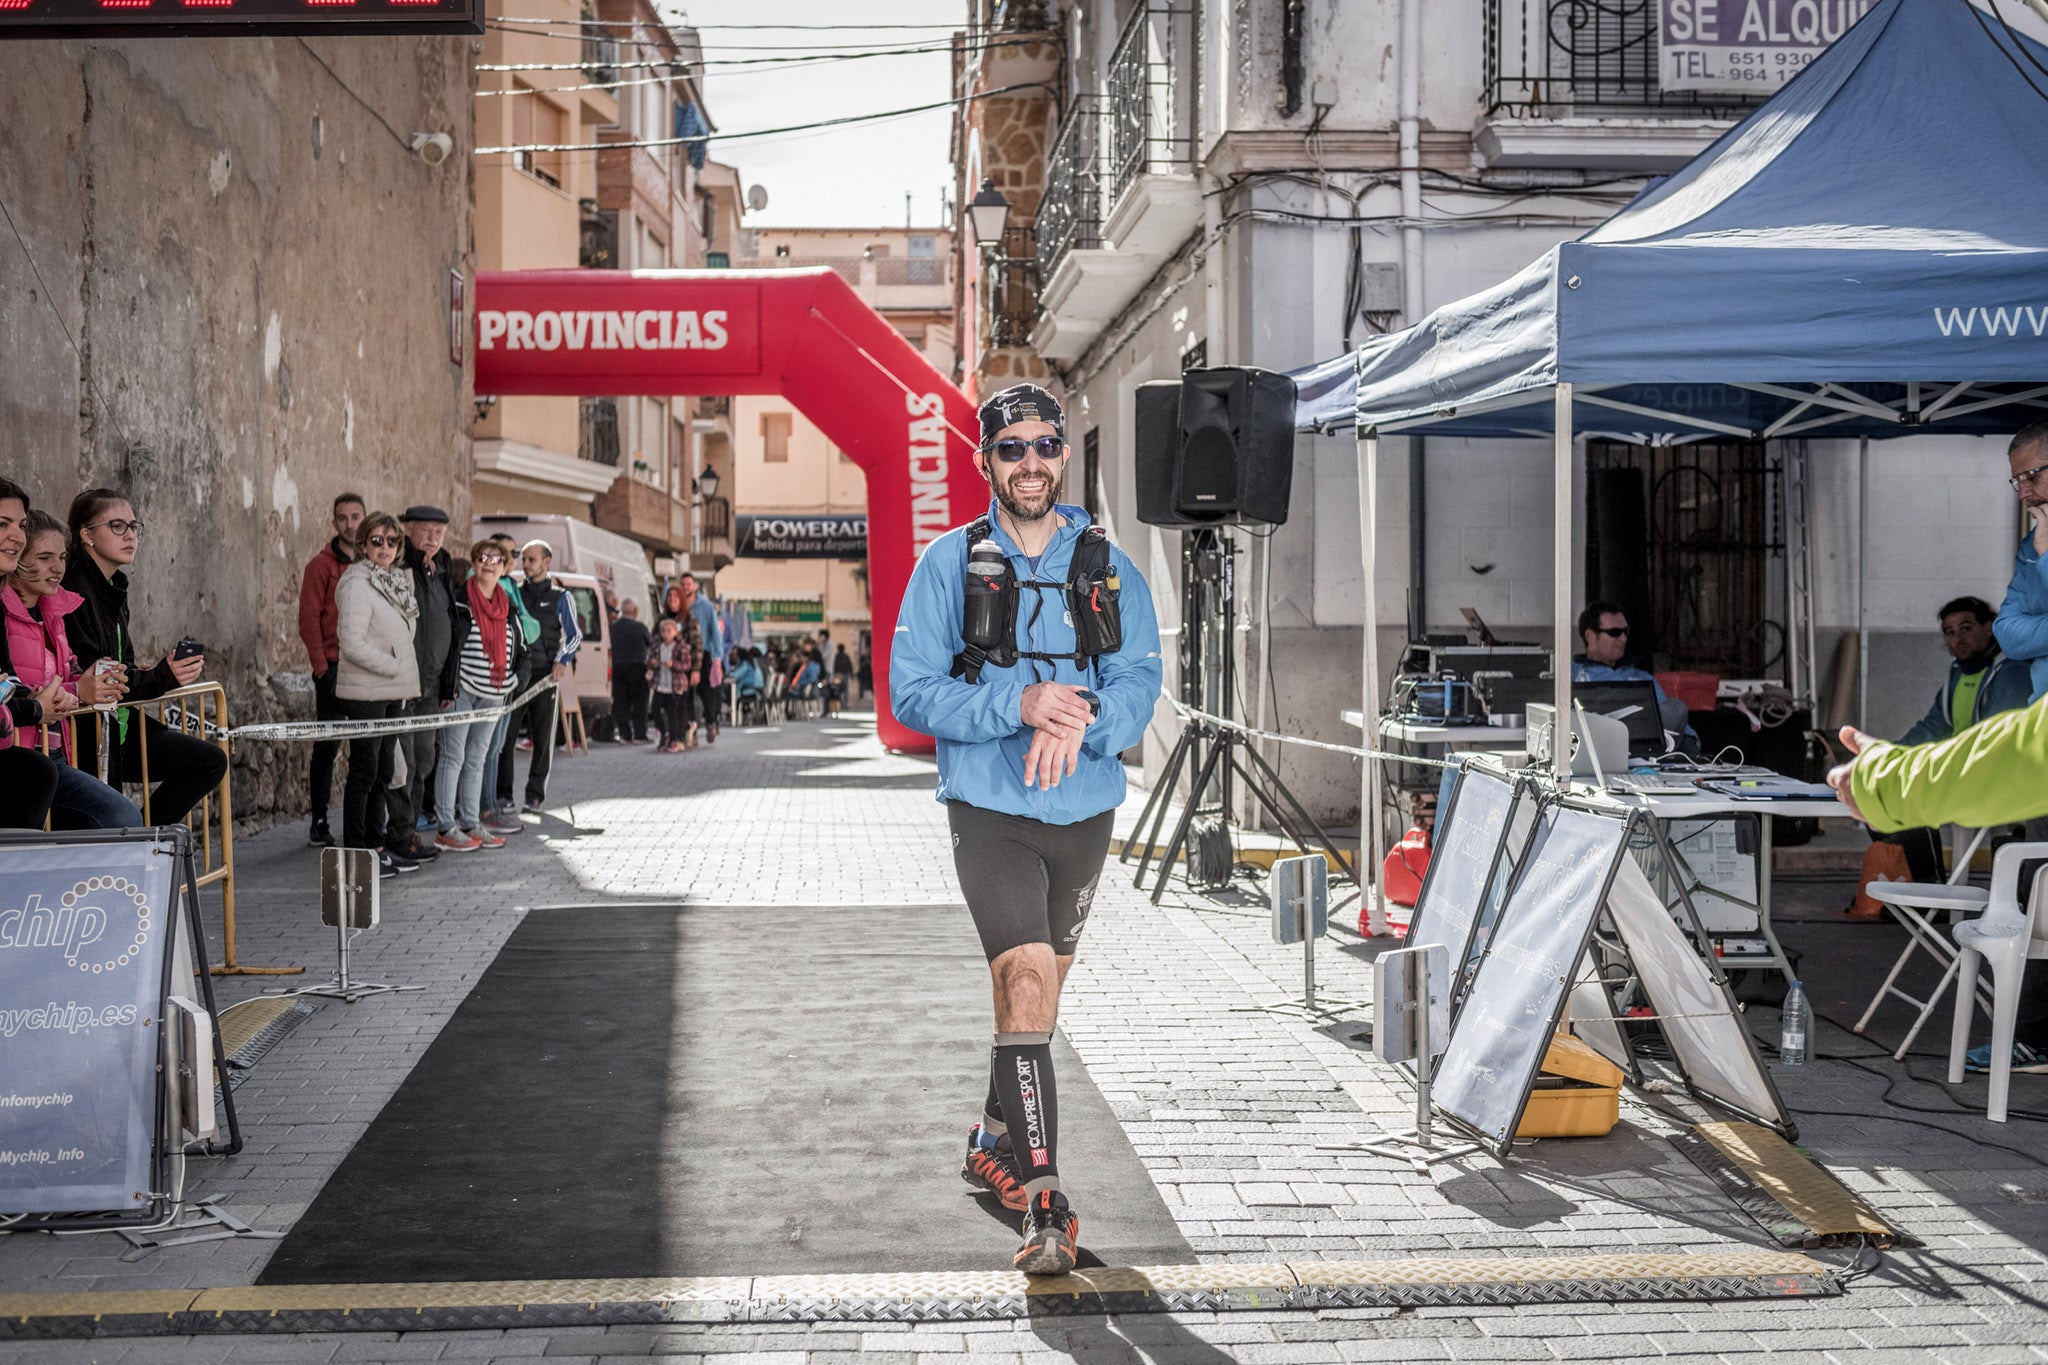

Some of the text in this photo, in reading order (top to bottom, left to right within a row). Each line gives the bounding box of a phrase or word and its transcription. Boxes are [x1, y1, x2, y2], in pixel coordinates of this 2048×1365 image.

[1669, 0, 1719, 41] SE
[1729, 53, 1813, 66] 651 930
[1730, 69, 1767, 82] 964
[479, 310, 729, 351] PROVINCIAS
[754, 519, 867, 538] POWERAD
[754, 538, 793, 550] bebida
[796, 541, 822, 553] para
